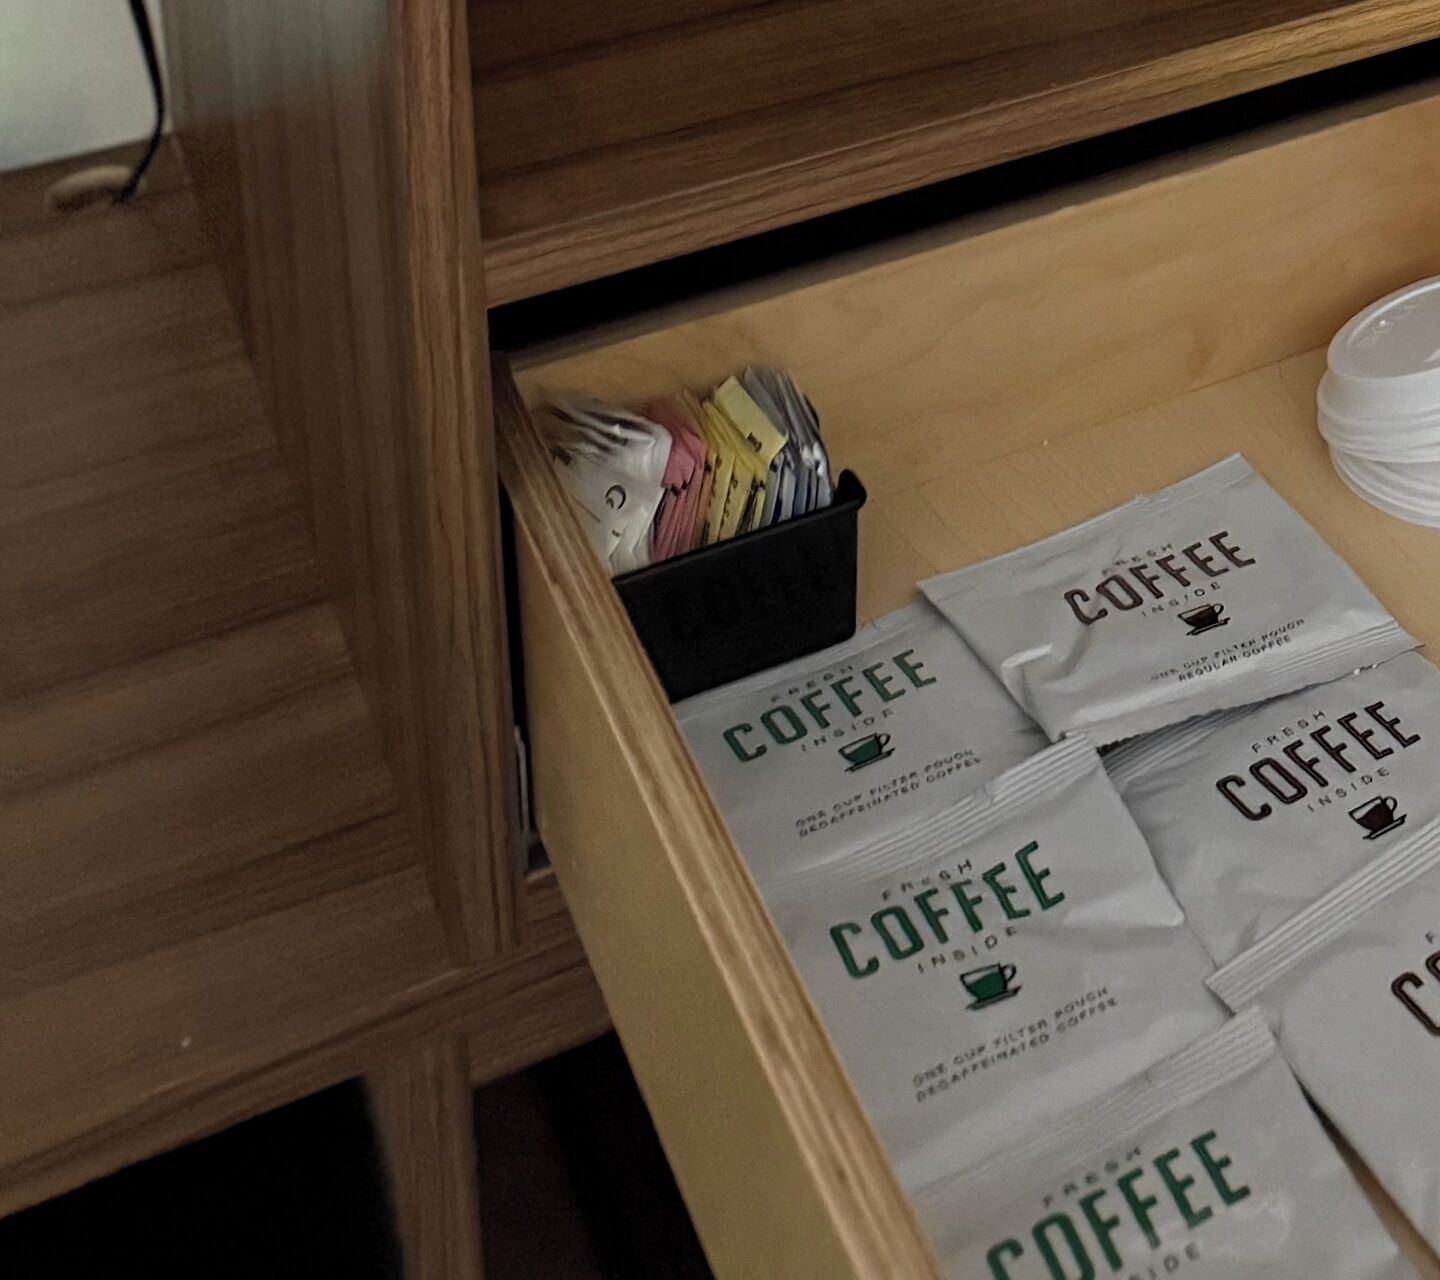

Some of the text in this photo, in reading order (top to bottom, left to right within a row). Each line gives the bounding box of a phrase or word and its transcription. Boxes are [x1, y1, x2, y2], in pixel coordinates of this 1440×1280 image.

[1063, 530, 1257, 625] COFFEE
[1141, 581, 1221, 618] INSIDE
[722, 648, 938, 763] COFFEE
[1251, 709, 1327, 754] FRESH
[1216, 700, 1422, 821] COFFEE
[1307, 765, 1391, 813] INSIDE
[829, 840, 1066, 980] COFFEE
[881, 858, 974, 902] FRESH
[917, 926, 1018, 974] INSIDE
[986, 1128, 1252, 1280] COFFEE
